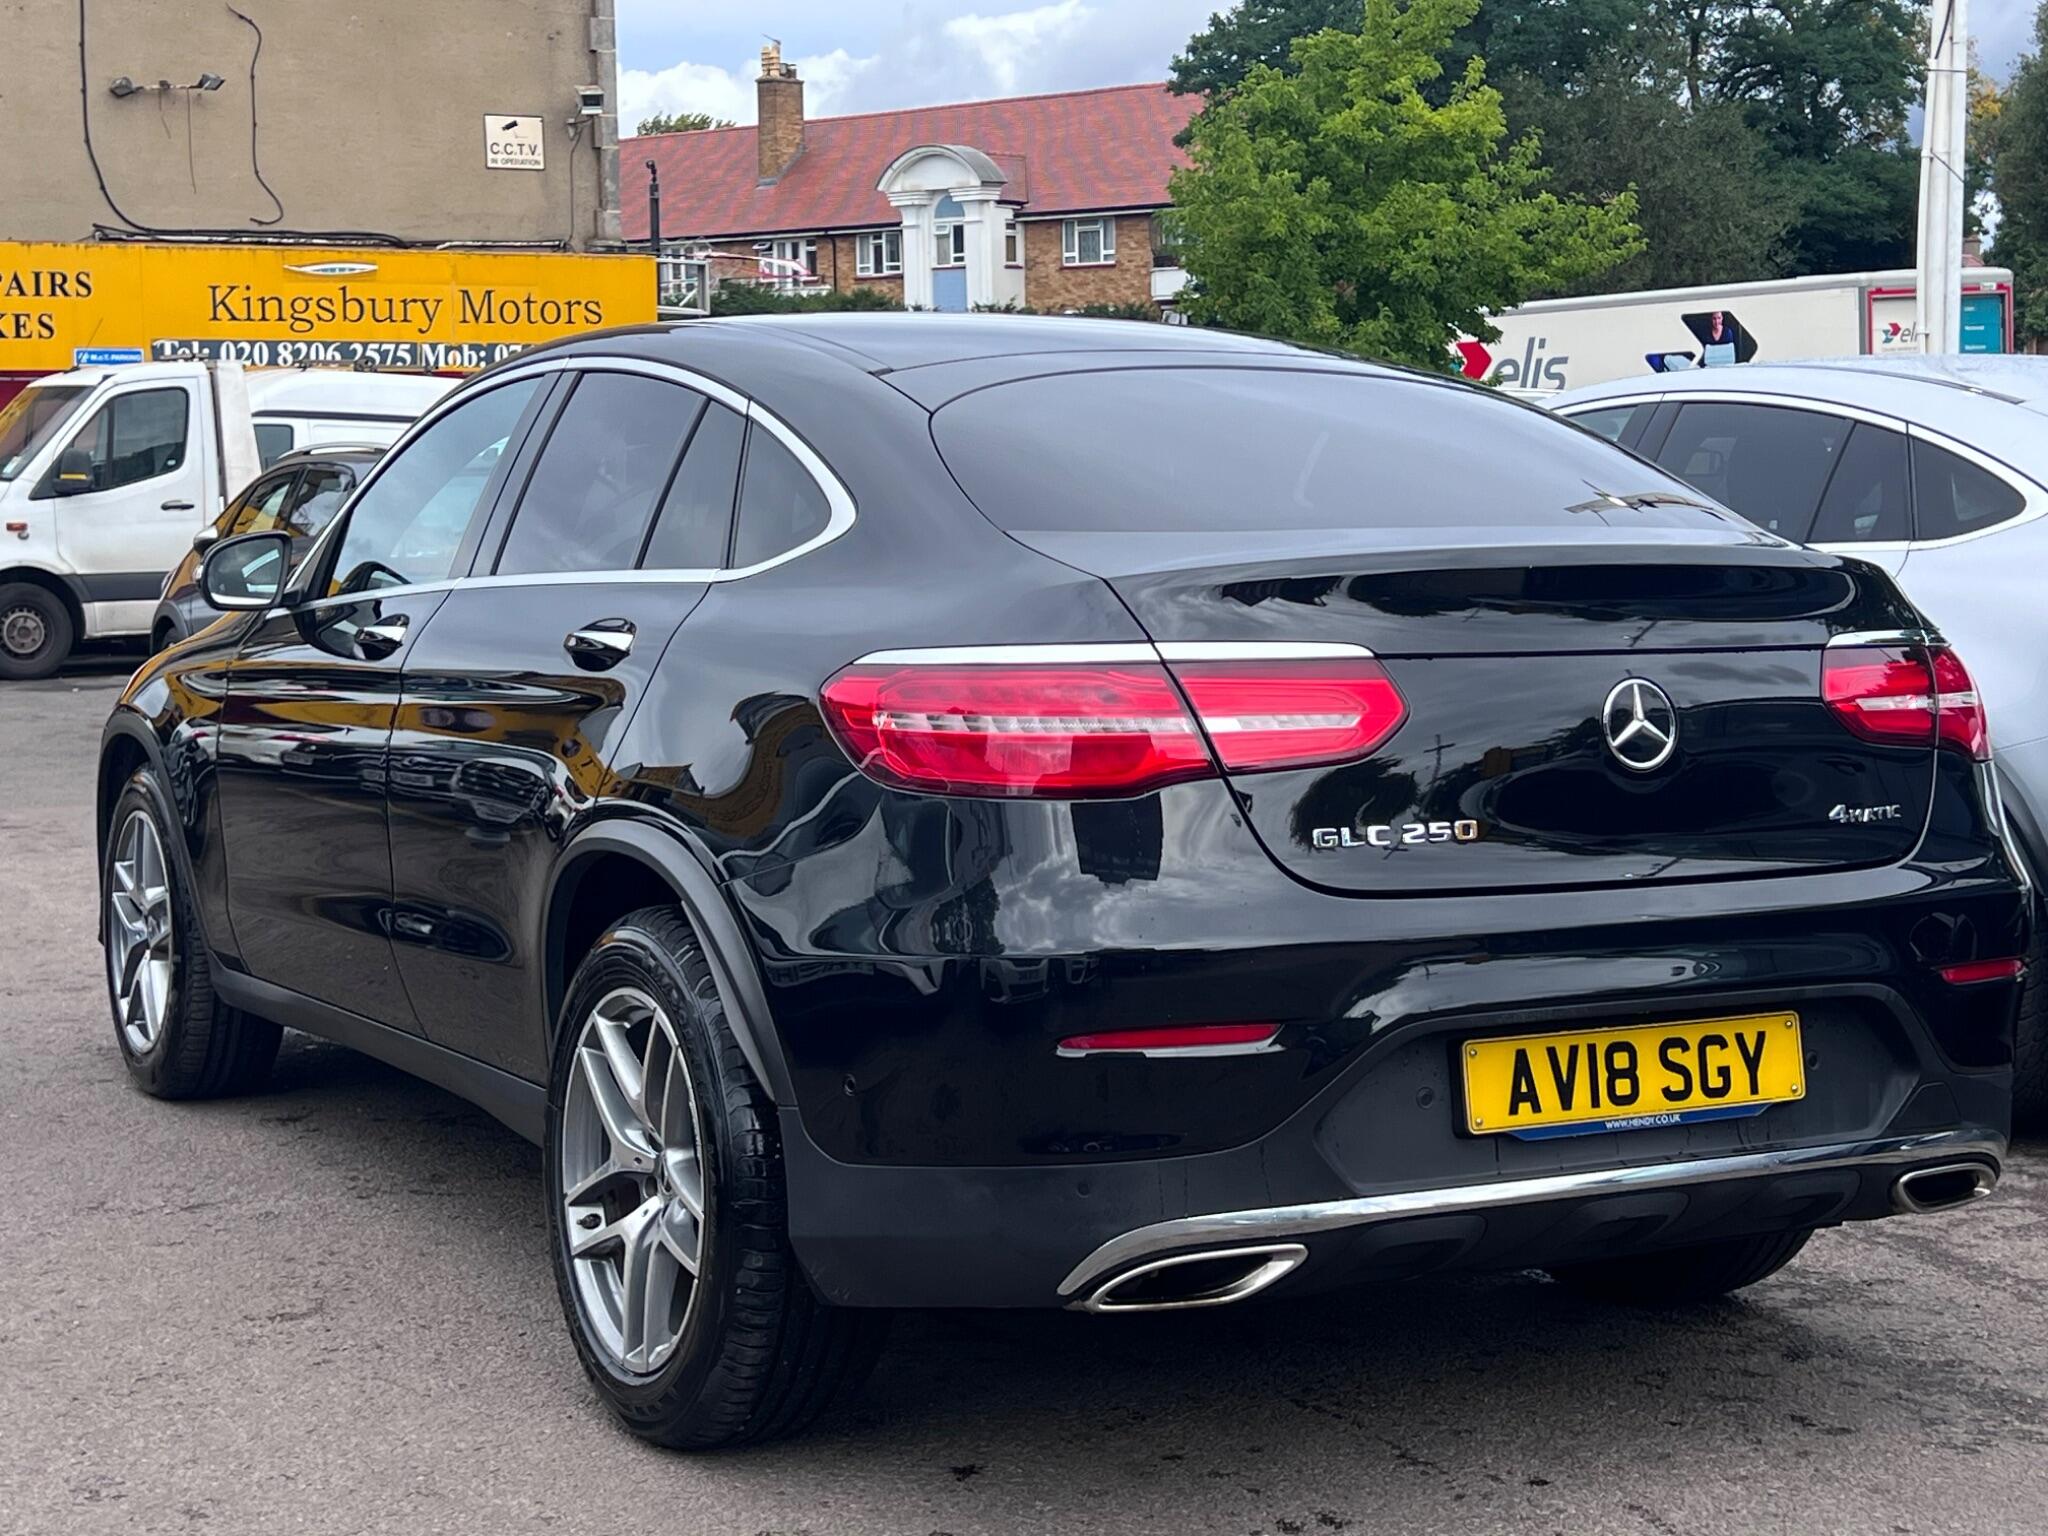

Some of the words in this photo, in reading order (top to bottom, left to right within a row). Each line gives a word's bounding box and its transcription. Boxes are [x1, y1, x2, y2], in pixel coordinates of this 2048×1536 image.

[0, 271, 92, 298] AIRS
[208, 284, 443, 334] Kingsbury
[459, 289, 603, 325] Motors
[220, 341, 269, 366] 020
[277, 341, 342, 366] 8206
[350, 342, 412, 367] 2575
[422, 344, 486, 368] Mob:
[1492, 336, 1569, 390] elis
[1312, 825, 1391, 848] GLC
[1402, 820, 1479, 844] 250
[1508, 1040, 1640, 1116] AV18
[1658, 1030, 1766, 1102] SGY
